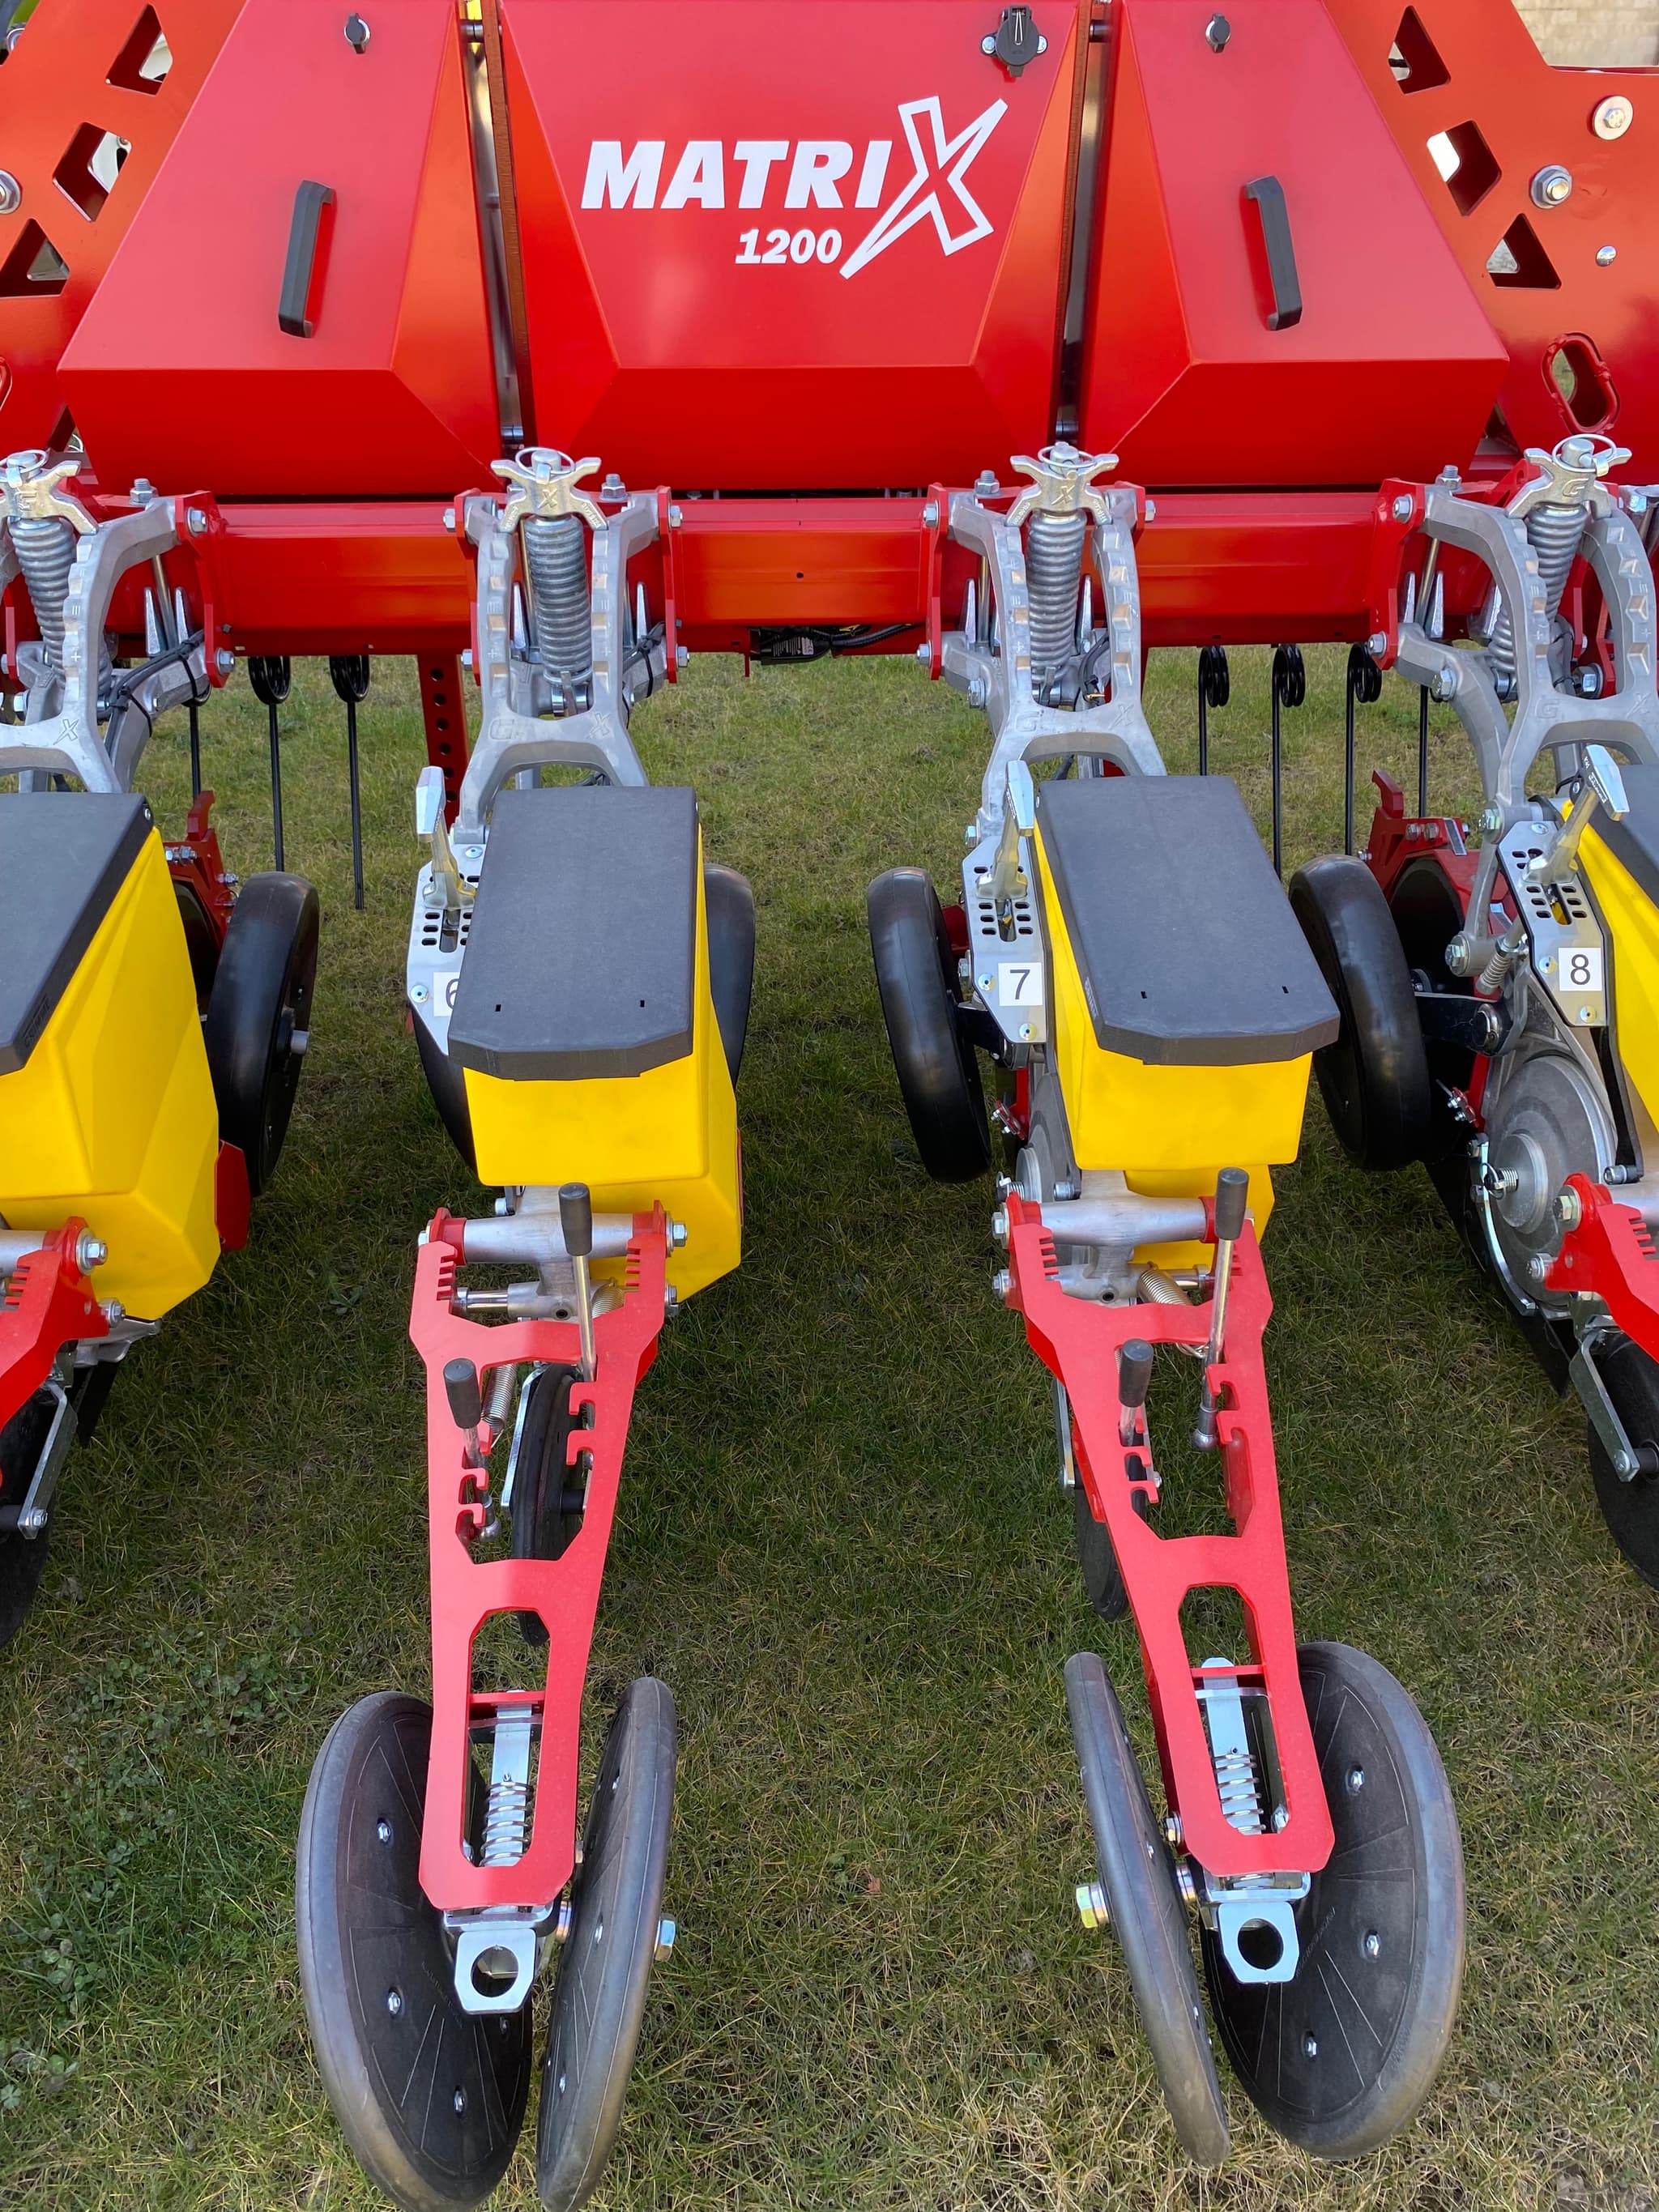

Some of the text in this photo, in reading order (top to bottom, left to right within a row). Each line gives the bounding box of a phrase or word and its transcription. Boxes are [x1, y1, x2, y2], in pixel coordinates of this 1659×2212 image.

[581, 96, 1008, 279] MATRIX
[735, 228, 842, 264] 1200
[1009, 969, 1031, 1000] 7
[1570, 953, 1591, 986] 8
